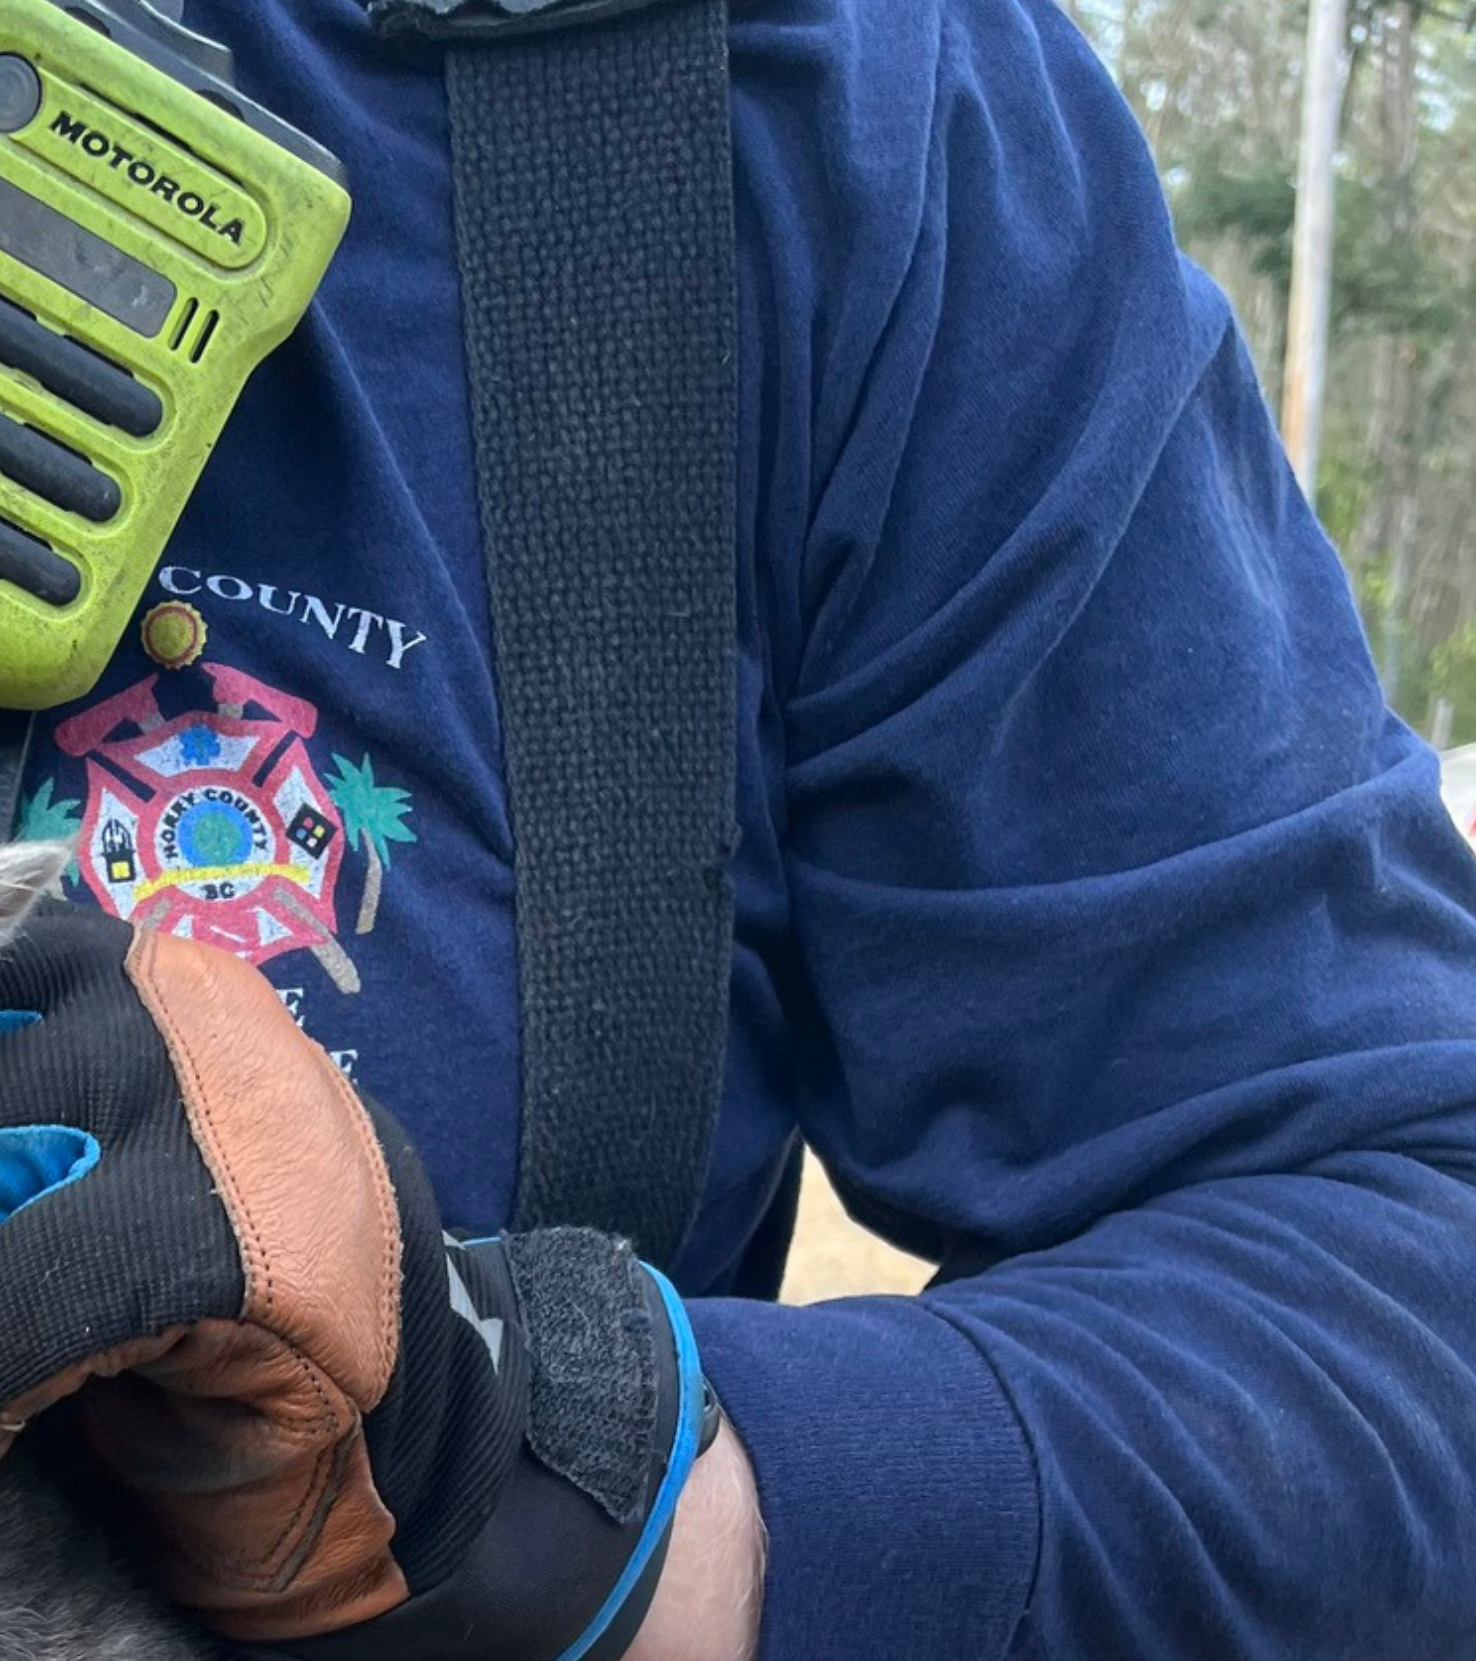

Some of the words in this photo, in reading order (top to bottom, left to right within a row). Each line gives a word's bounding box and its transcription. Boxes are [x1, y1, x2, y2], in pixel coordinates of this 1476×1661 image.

[48, 109, 245, 247] MOTOROLA
[158, 564, 427, 670] COUNTY
[160, 790, 196, 860] HORRY
[203, 788, 268, 850] COUNTY
